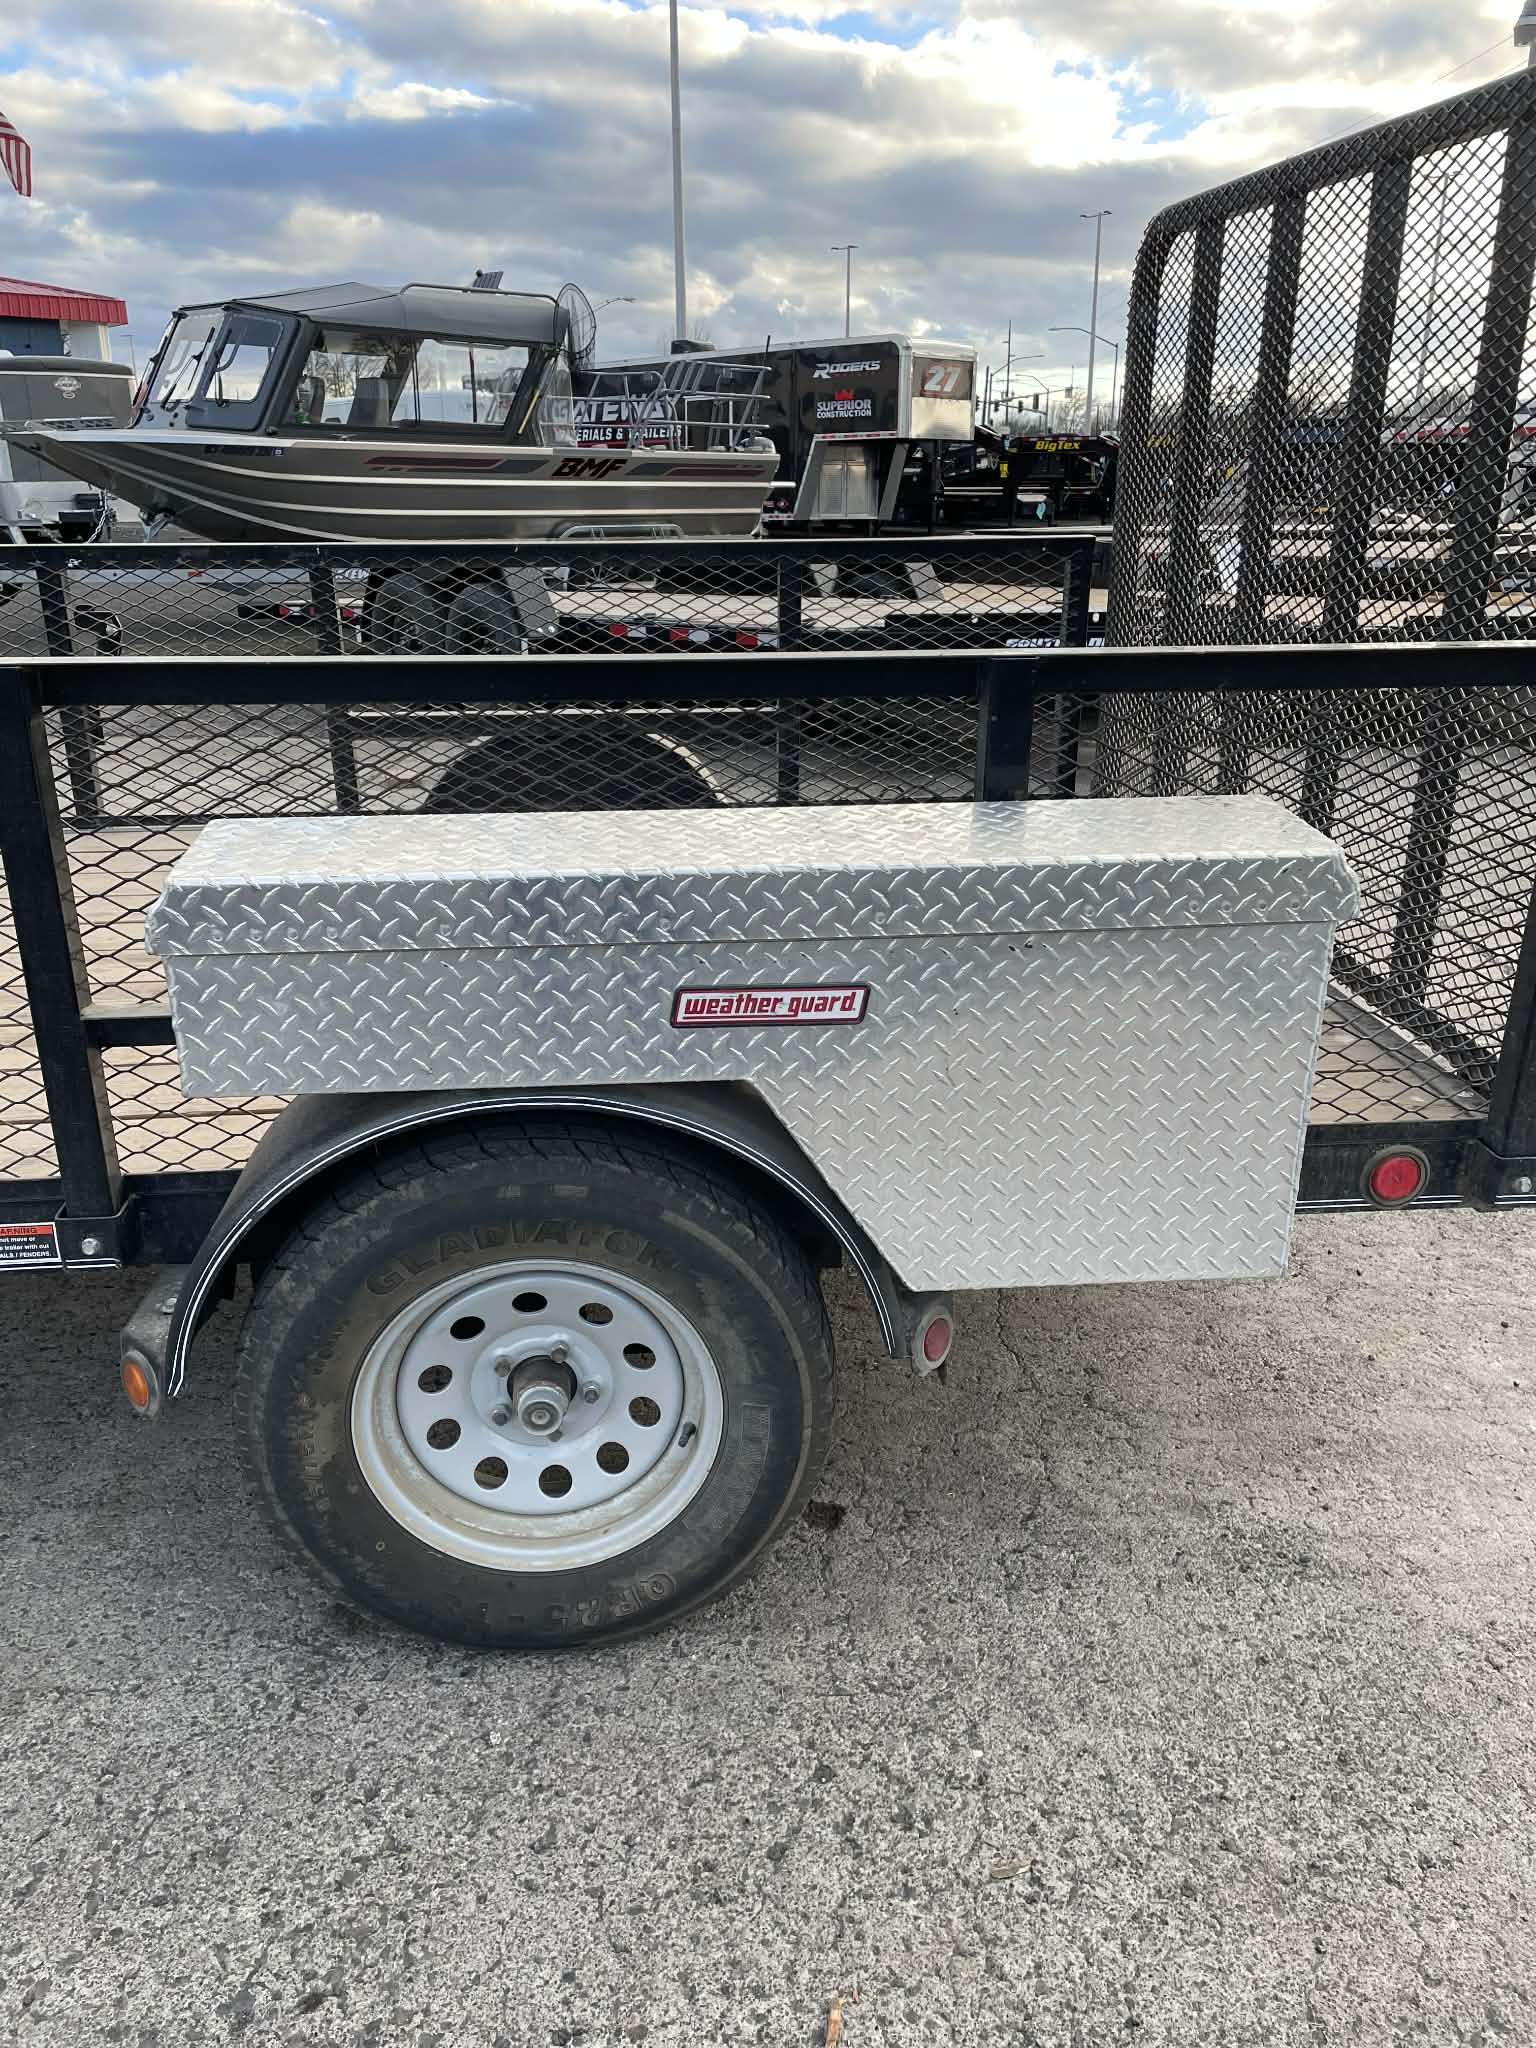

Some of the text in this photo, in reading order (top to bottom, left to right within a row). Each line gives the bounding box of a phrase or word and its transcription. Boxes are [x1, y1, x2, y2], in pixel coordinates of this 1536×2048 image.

[812, 360, 881, 379] ROGERS
[923, 363, 961, 392] 27
[816, 409, 872, 419] CONSTRUCTION
[817, 399, 871, 411] SUPERIOR
[615, 429, 624, 440] &
[552, 458, 628, 479] BMF
[684, 991, 857, 1017] weather guard
[0, 1227, 37, 1235] ARNING
[366, 1218, 672, 1296] GLADIATOR
